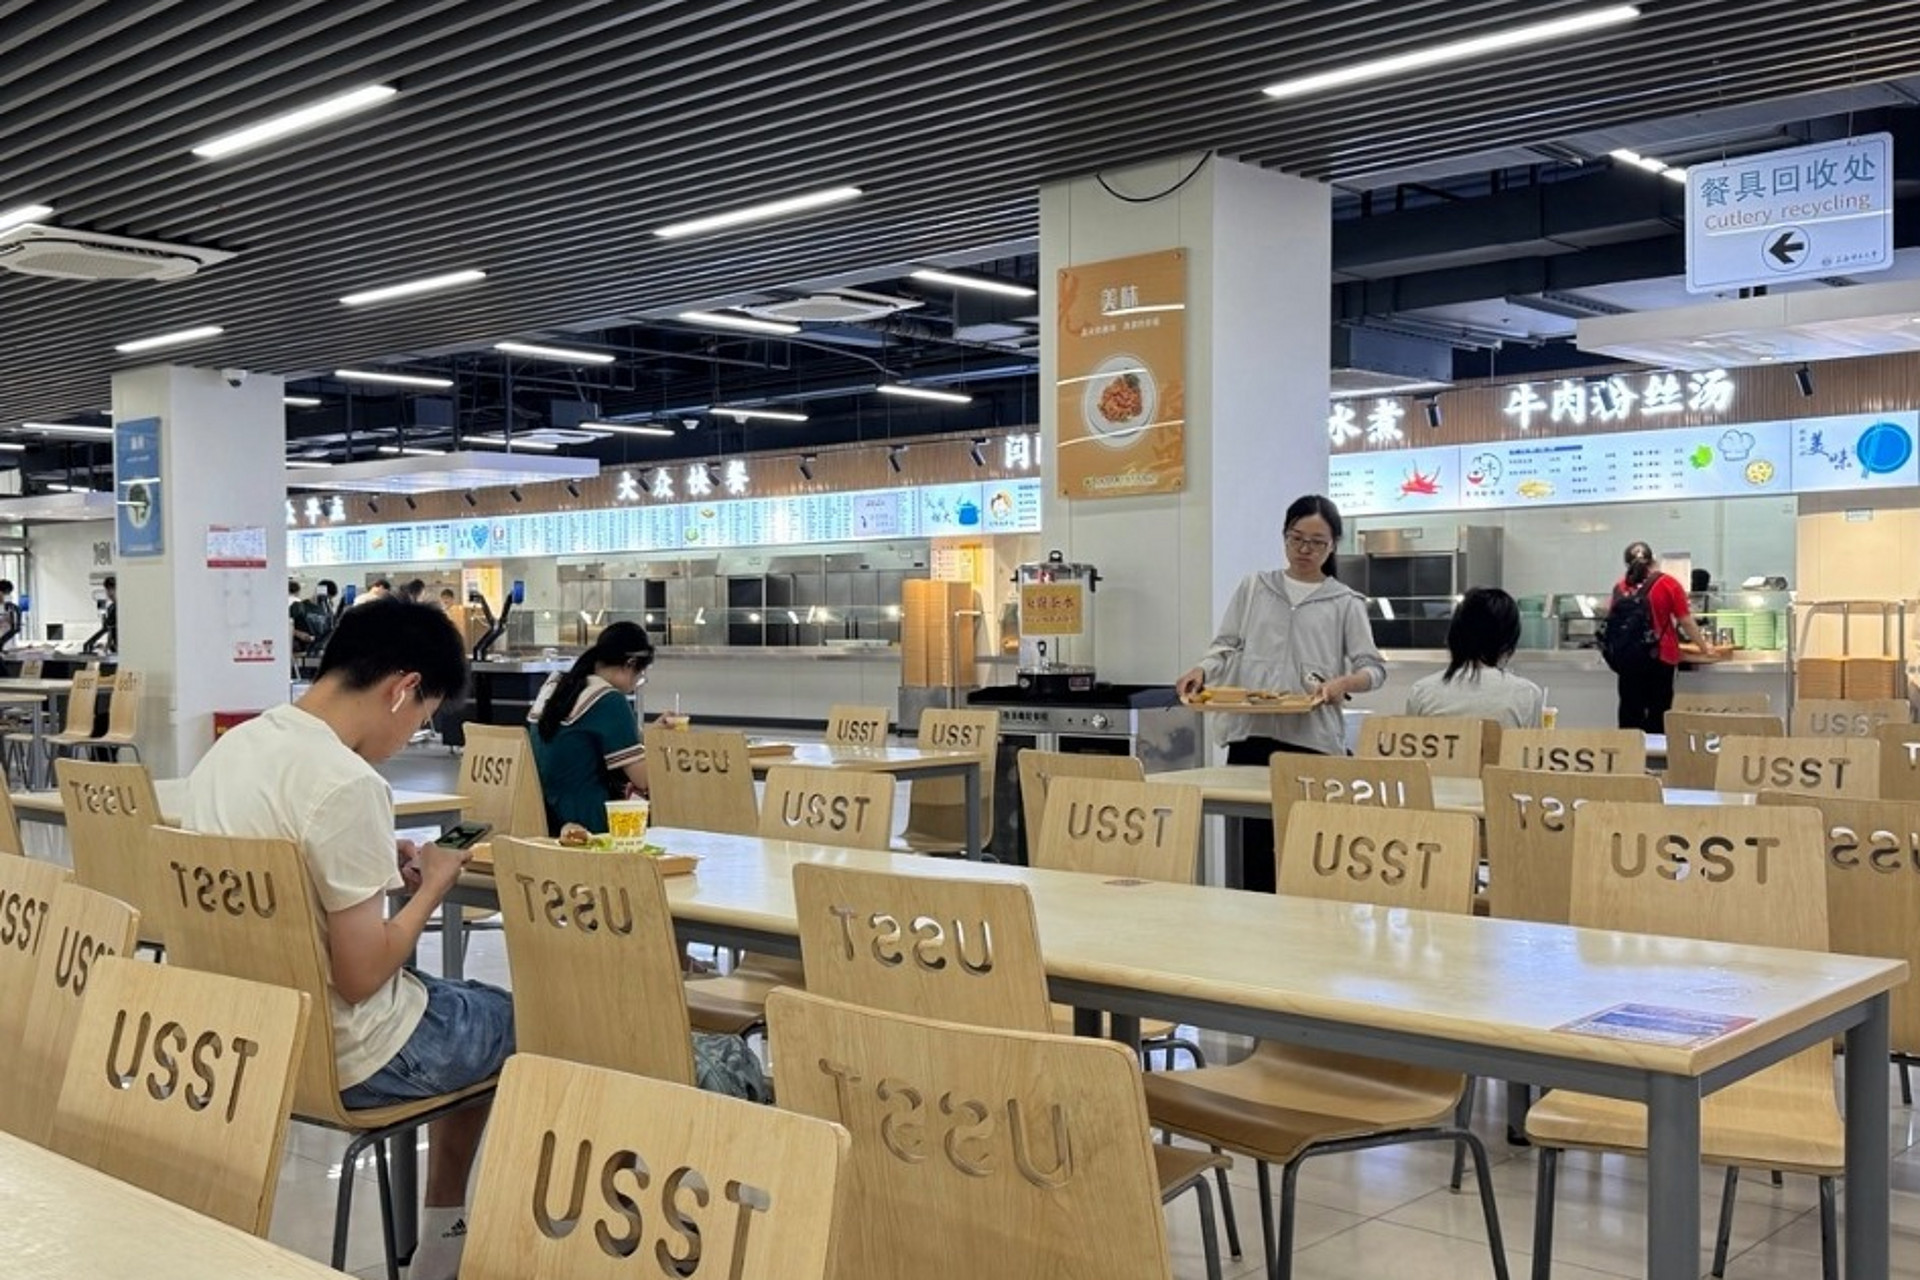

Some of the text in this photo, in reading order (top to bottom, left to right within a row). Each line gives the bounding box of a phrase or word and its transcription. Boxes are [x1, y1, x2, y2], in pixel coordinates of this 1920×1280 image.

[1700, 153, 1877, 208] 餐具回收处
[1704, 193, 1872, 231] Cutlery recycling
[1503, 368, 1735, 430] 牛肉粉丝汤
[837, 719, 879, 743] USST
[931, 723, 986, 747] USST
[1377, 731, 1459, 759] USST
[470, 755, 513, 786] USST
[1523, 746, 1619, 773] USST
[1742, 755, 1852, 789] USST
[781, 790, 871, 833] USST
[1068, 802, 1173, 847] USST
[1313, 832, 1442, 889] USST
[1611, 831, 1780, 885] USST
[0, 890, 48, 956] SST
[55, 926, 115, 996] US
[106, 1009, 258, 1124] USST
[533, 1129, 771, 1280] USST
